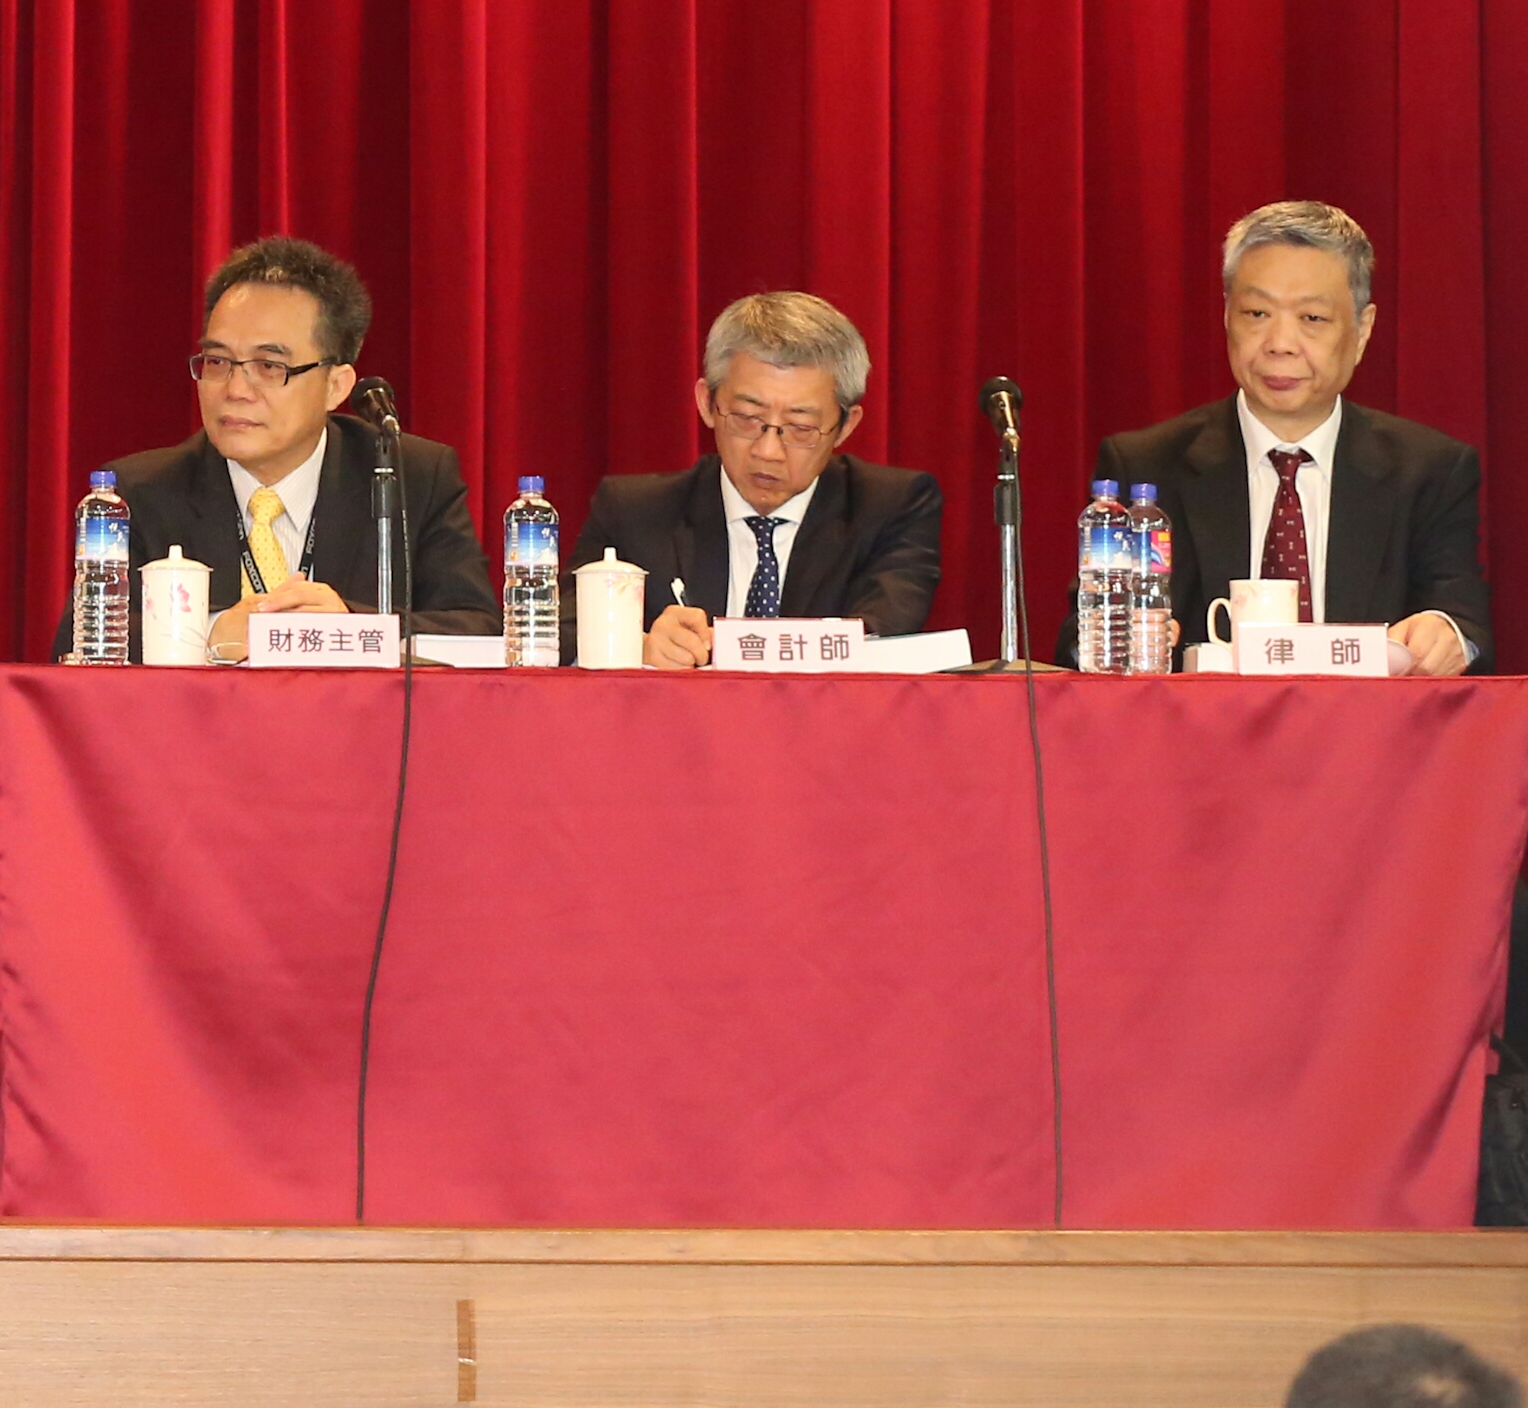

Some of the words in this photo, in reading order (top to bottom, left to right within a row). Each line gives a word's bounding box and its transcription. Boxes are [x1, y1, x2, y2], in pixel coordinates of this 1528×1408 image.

[268, 628, 384, 654] 財務主管
[737, 633, 850, 661] 會計師
[1264, 637, 1361, 665] 律師
